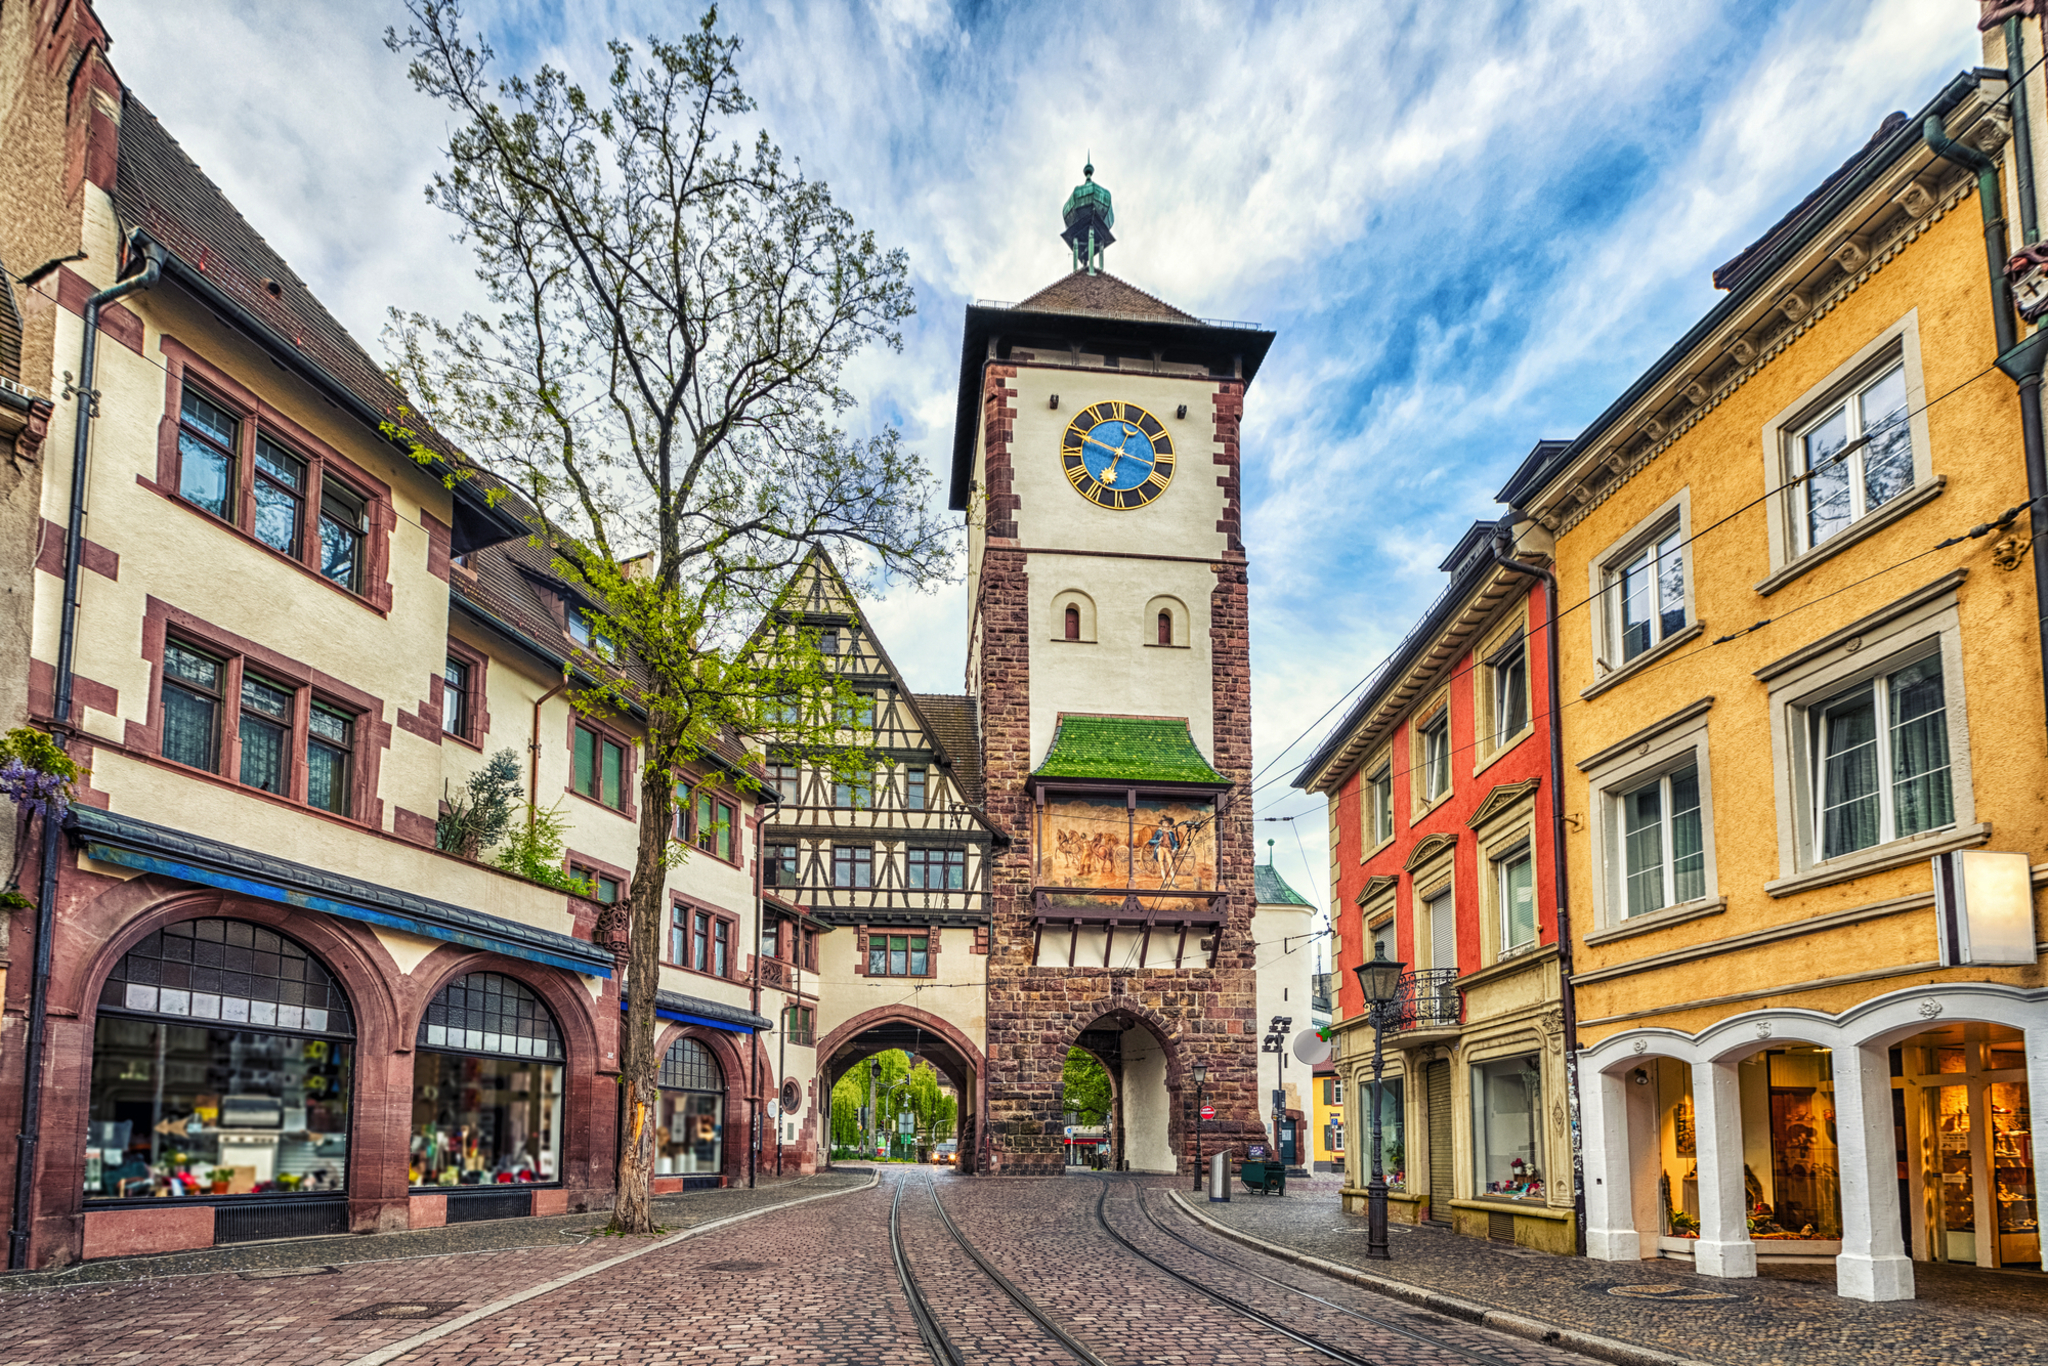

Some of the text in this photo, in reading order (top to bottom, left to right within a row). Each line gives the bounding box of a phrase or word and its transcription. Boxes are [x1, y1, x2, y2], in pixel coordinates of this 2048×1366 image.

[1086, 405, 1103, 424] XI
[1111, 402, 1126, 420] XII
[1137, 411, 1147, 426] I
[1068, 422, 1088, 436] X
[1151, 430, 1167, 441] II
[1063, 445, 1081, 456] IX
[1156, 453, 1174, 464] III
[1067, 464, 1087, 485] VIII
[1148, 471, 1169, 490] IIII
[1086, 481, 1103, 502] VII
[1114, 490, 1126, 508] VI
[1137, 488, 1149, 504] V
